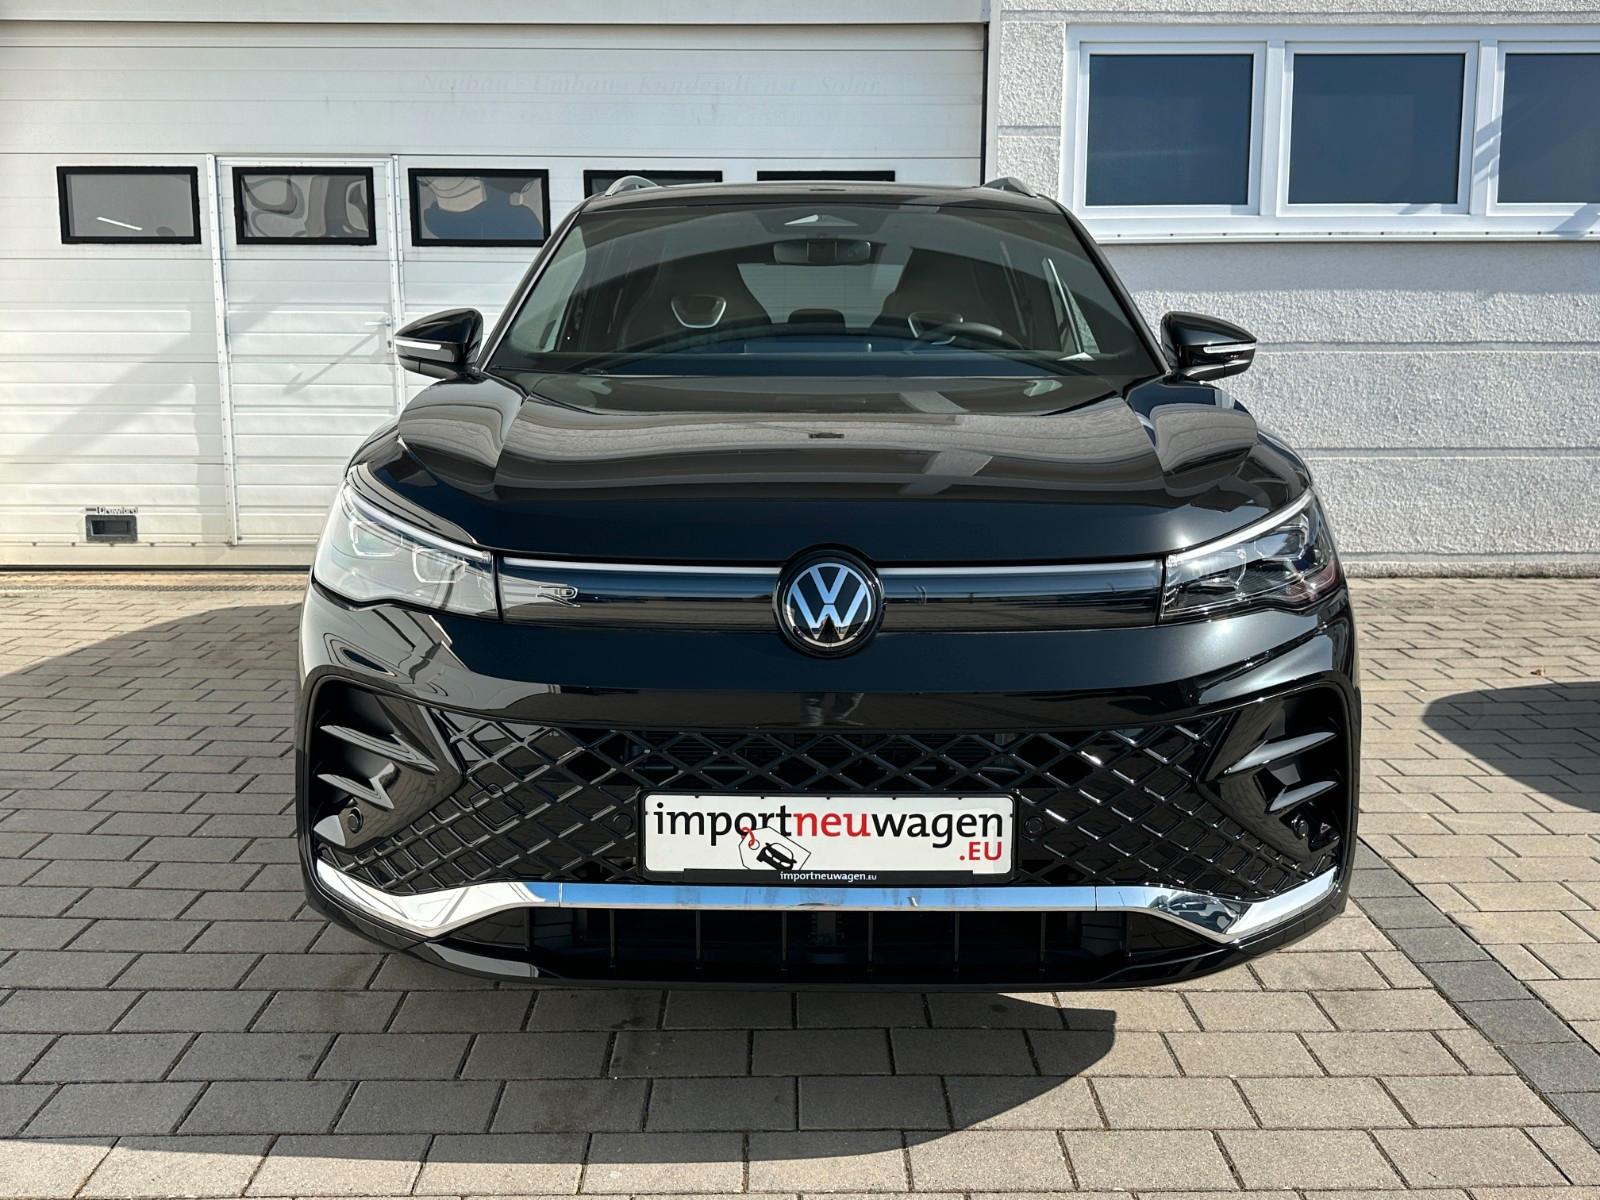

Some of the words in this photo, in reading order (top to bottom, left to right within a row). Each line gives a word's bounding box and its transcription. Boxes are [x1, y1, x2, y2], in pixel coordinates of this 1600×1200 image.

[787, 562, 871, 647] VW
[653, 802, 1003, 848] importneuwagen
[959, 841, 1003, 861] .EU
